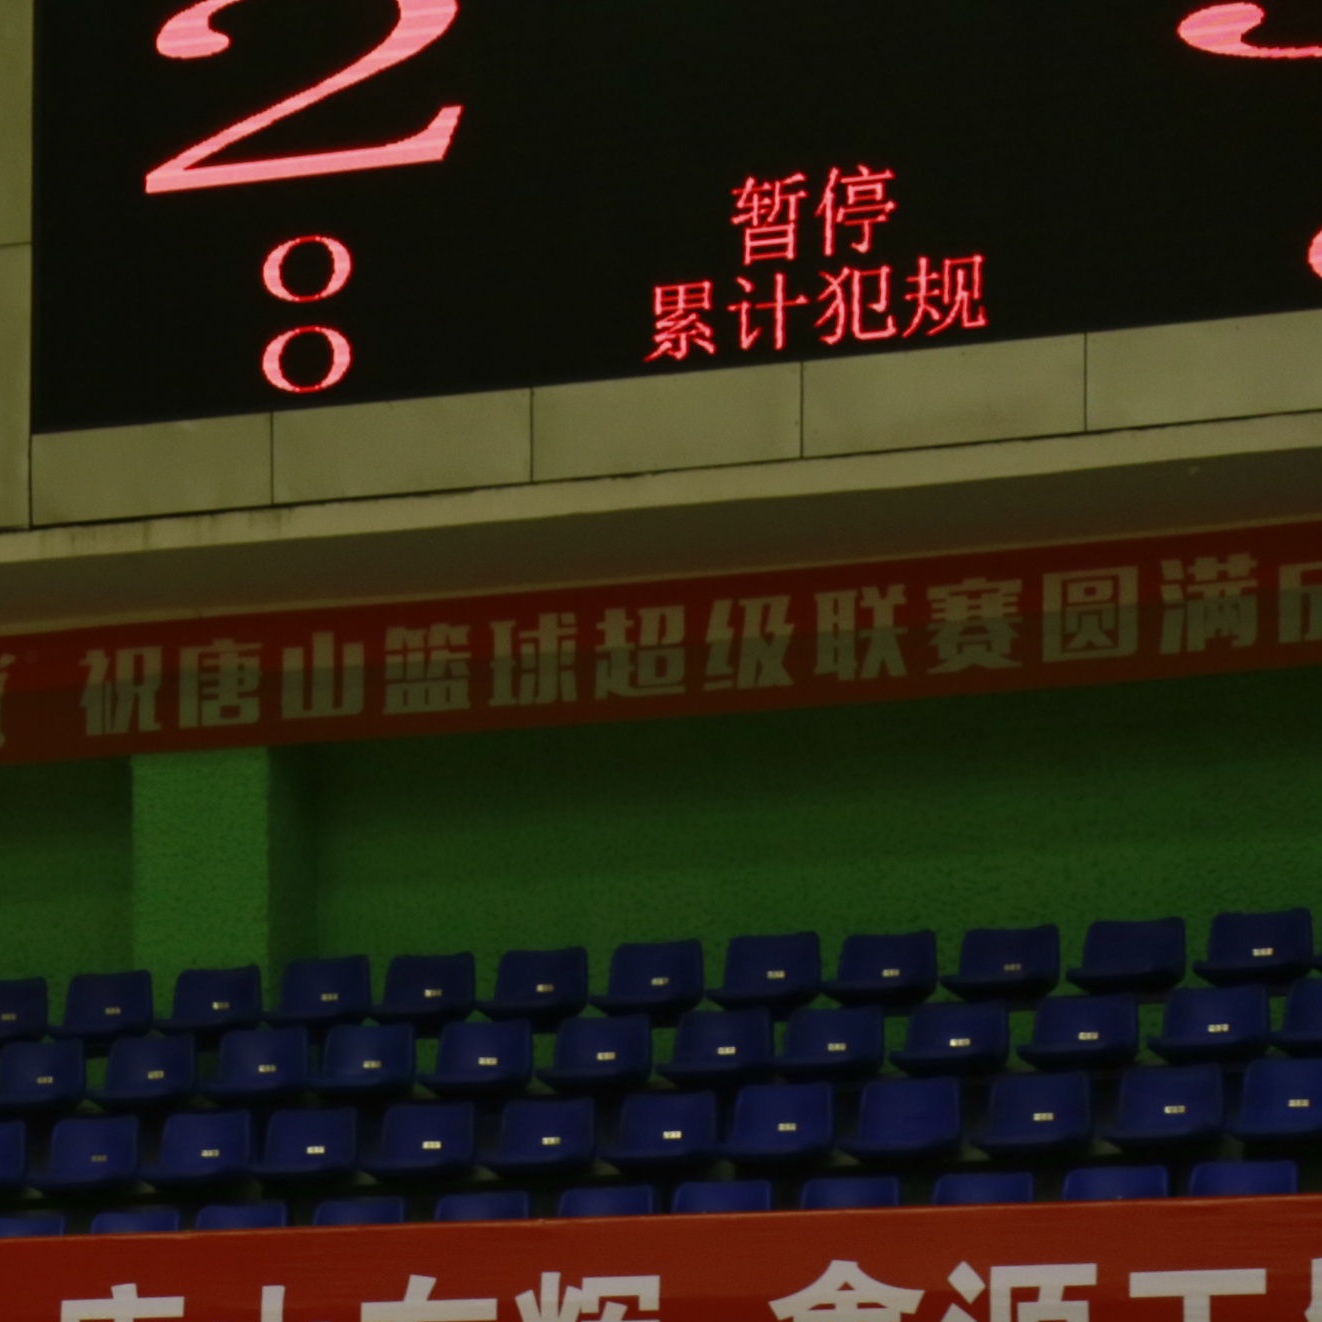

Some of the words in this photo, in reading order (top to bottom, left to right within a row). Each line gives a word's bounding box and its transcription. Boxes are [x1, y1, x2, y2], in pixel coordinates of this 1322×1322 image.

[146, 0, 461, 193] 2
[729, 165, 896, 267] 暂停
[262, 235, 352, 302] 0
[644, 254, 988, 362] 累计犯规
[262, 325, 352, 392] 0
